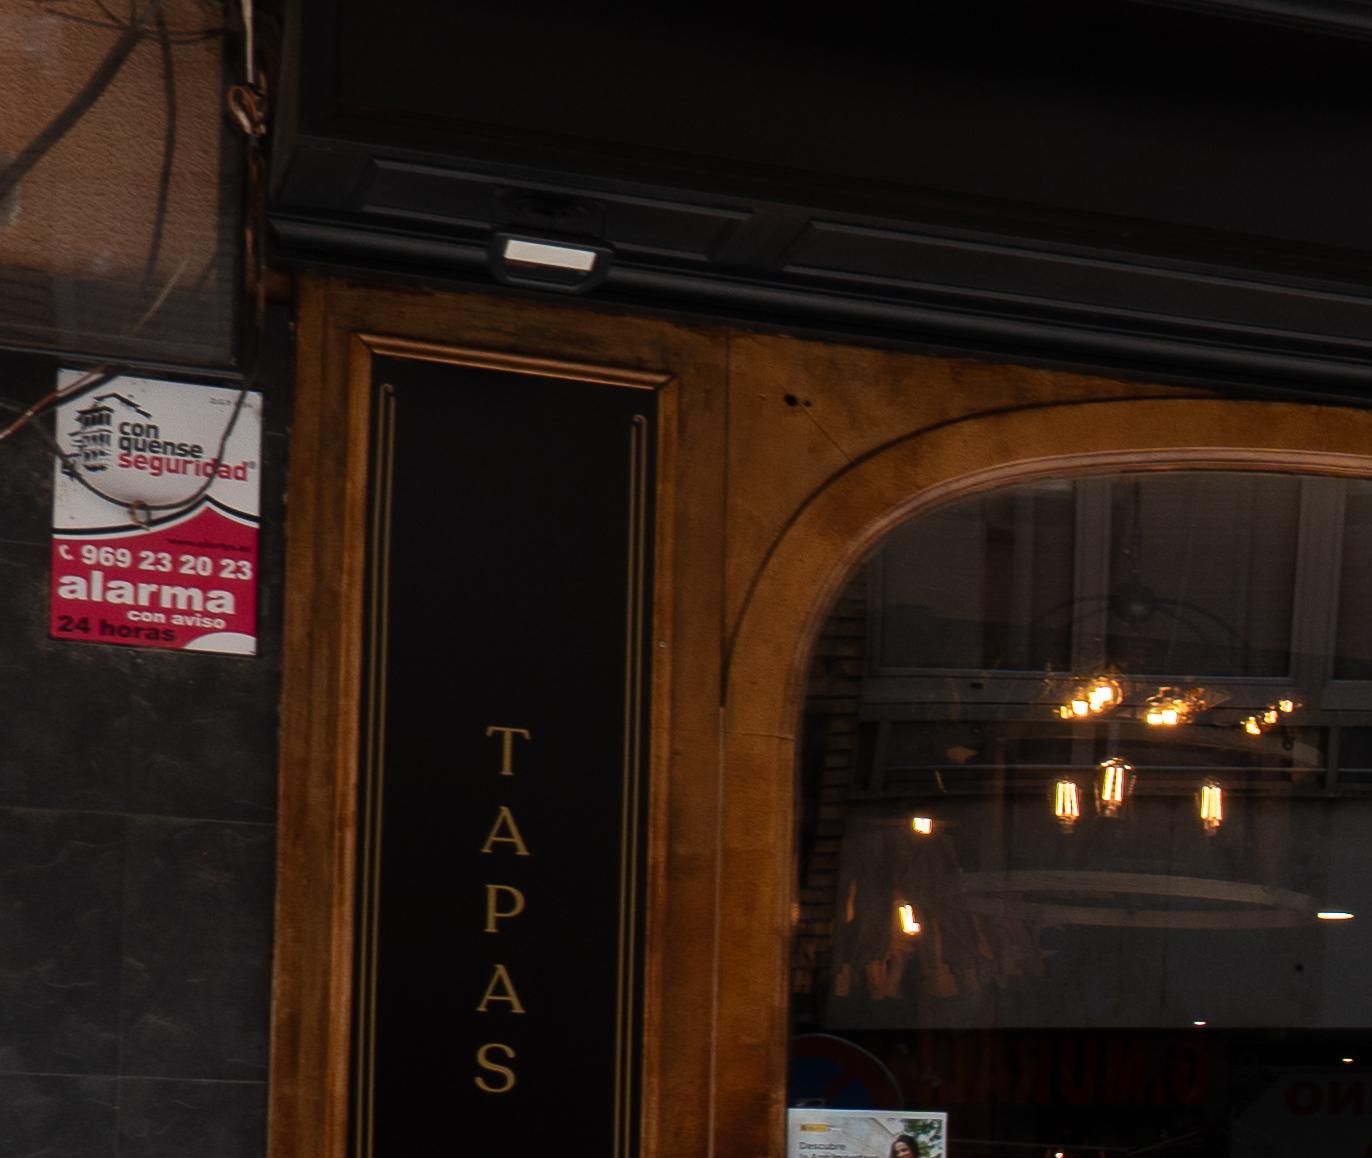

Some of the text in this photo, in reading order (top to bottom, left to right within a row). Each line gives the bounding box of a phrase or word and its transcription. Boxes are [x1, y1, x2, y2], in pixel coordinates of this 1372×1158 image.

[119, 421, 160, 439] con
[119, 435, 204, 458] quense
[118, 452, 249, 482] seguridad
[81, 544, 253, 580] 969 23 20 23
[57, 570, 236, 614] alarma
[57, 615, 176, 642] 24 horas
[126, 610, 226, 629] con aviso
[475, 725, 531, 1093] TAPAS
